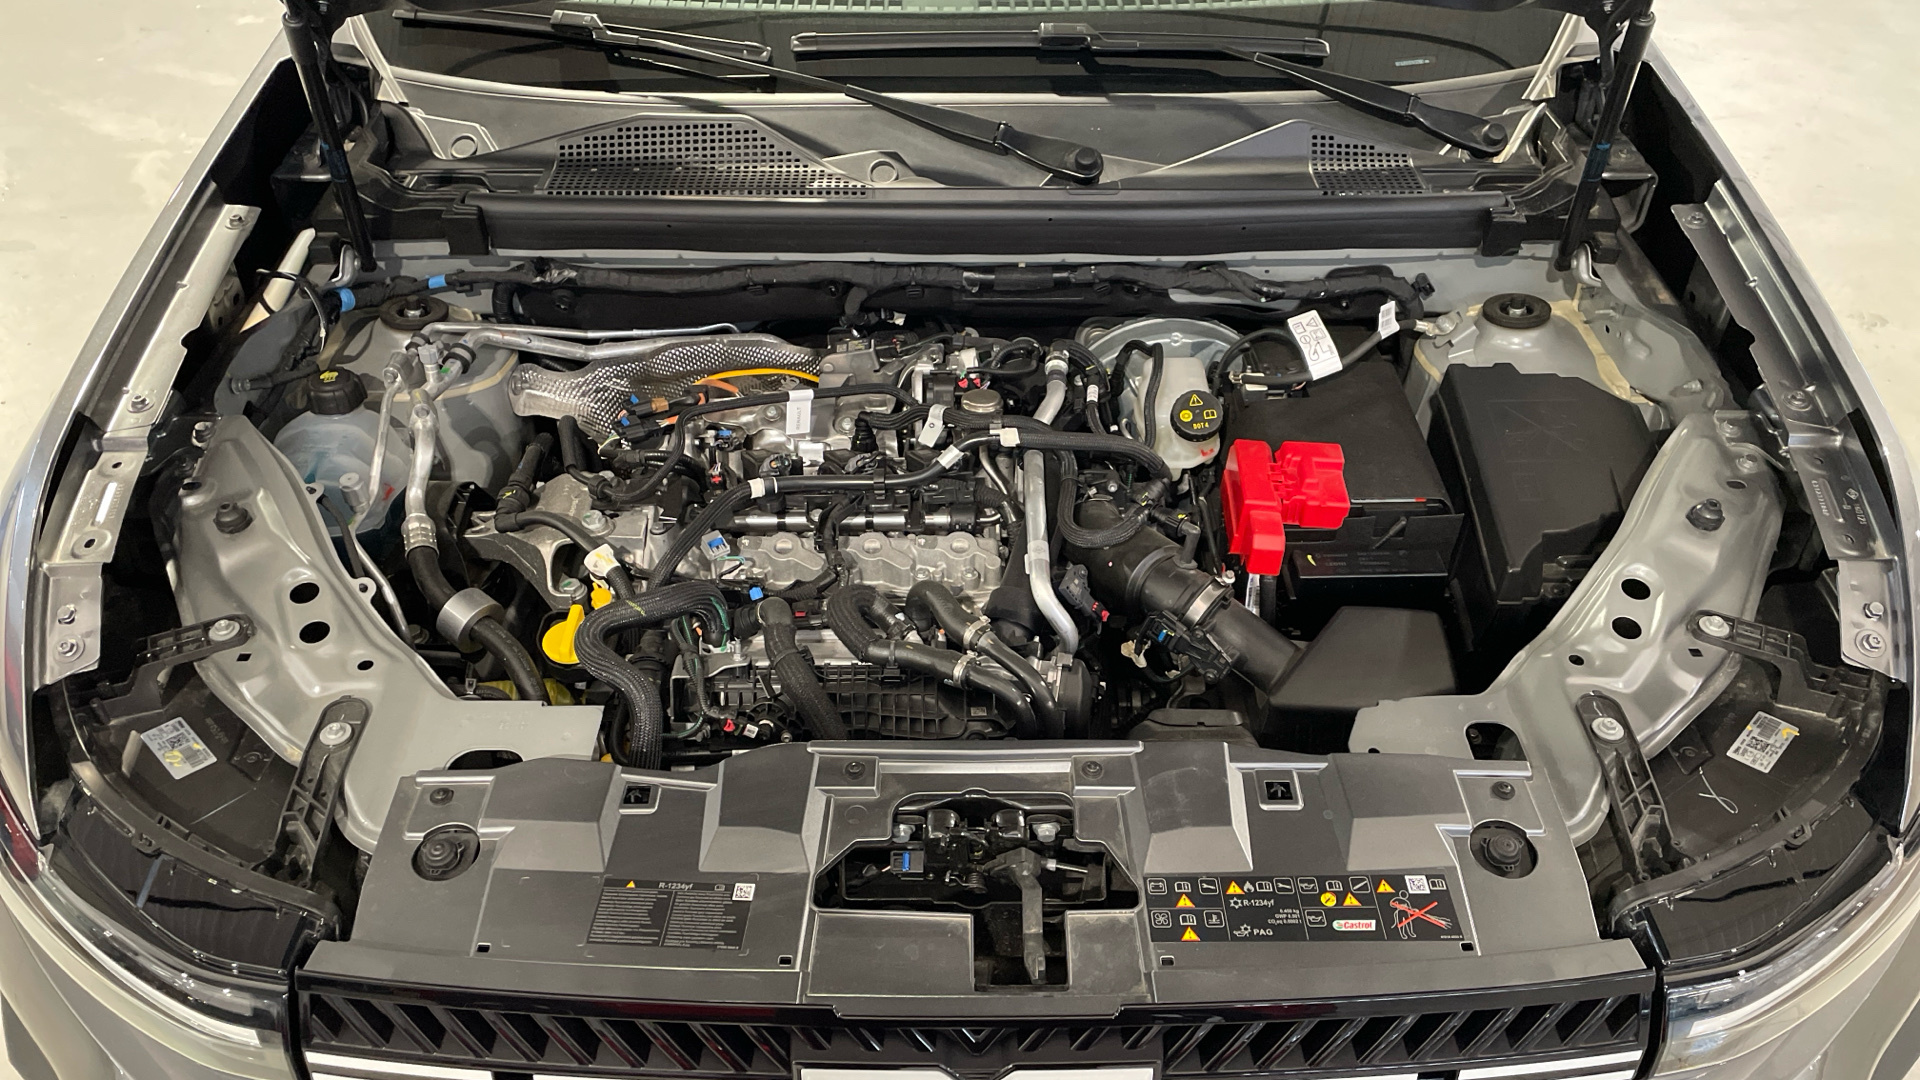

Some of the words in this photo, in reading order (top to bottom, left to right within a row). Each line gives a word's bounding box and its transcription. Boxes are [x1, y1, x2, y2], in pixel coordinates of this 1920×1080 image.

[658, 882, 694, 891] R-1234yf
[1243, 899, 1274, 908] R-1234yf
[1343, 921, 1373, 930] Castrol
[1253, 928, 1273, 936] PAG
